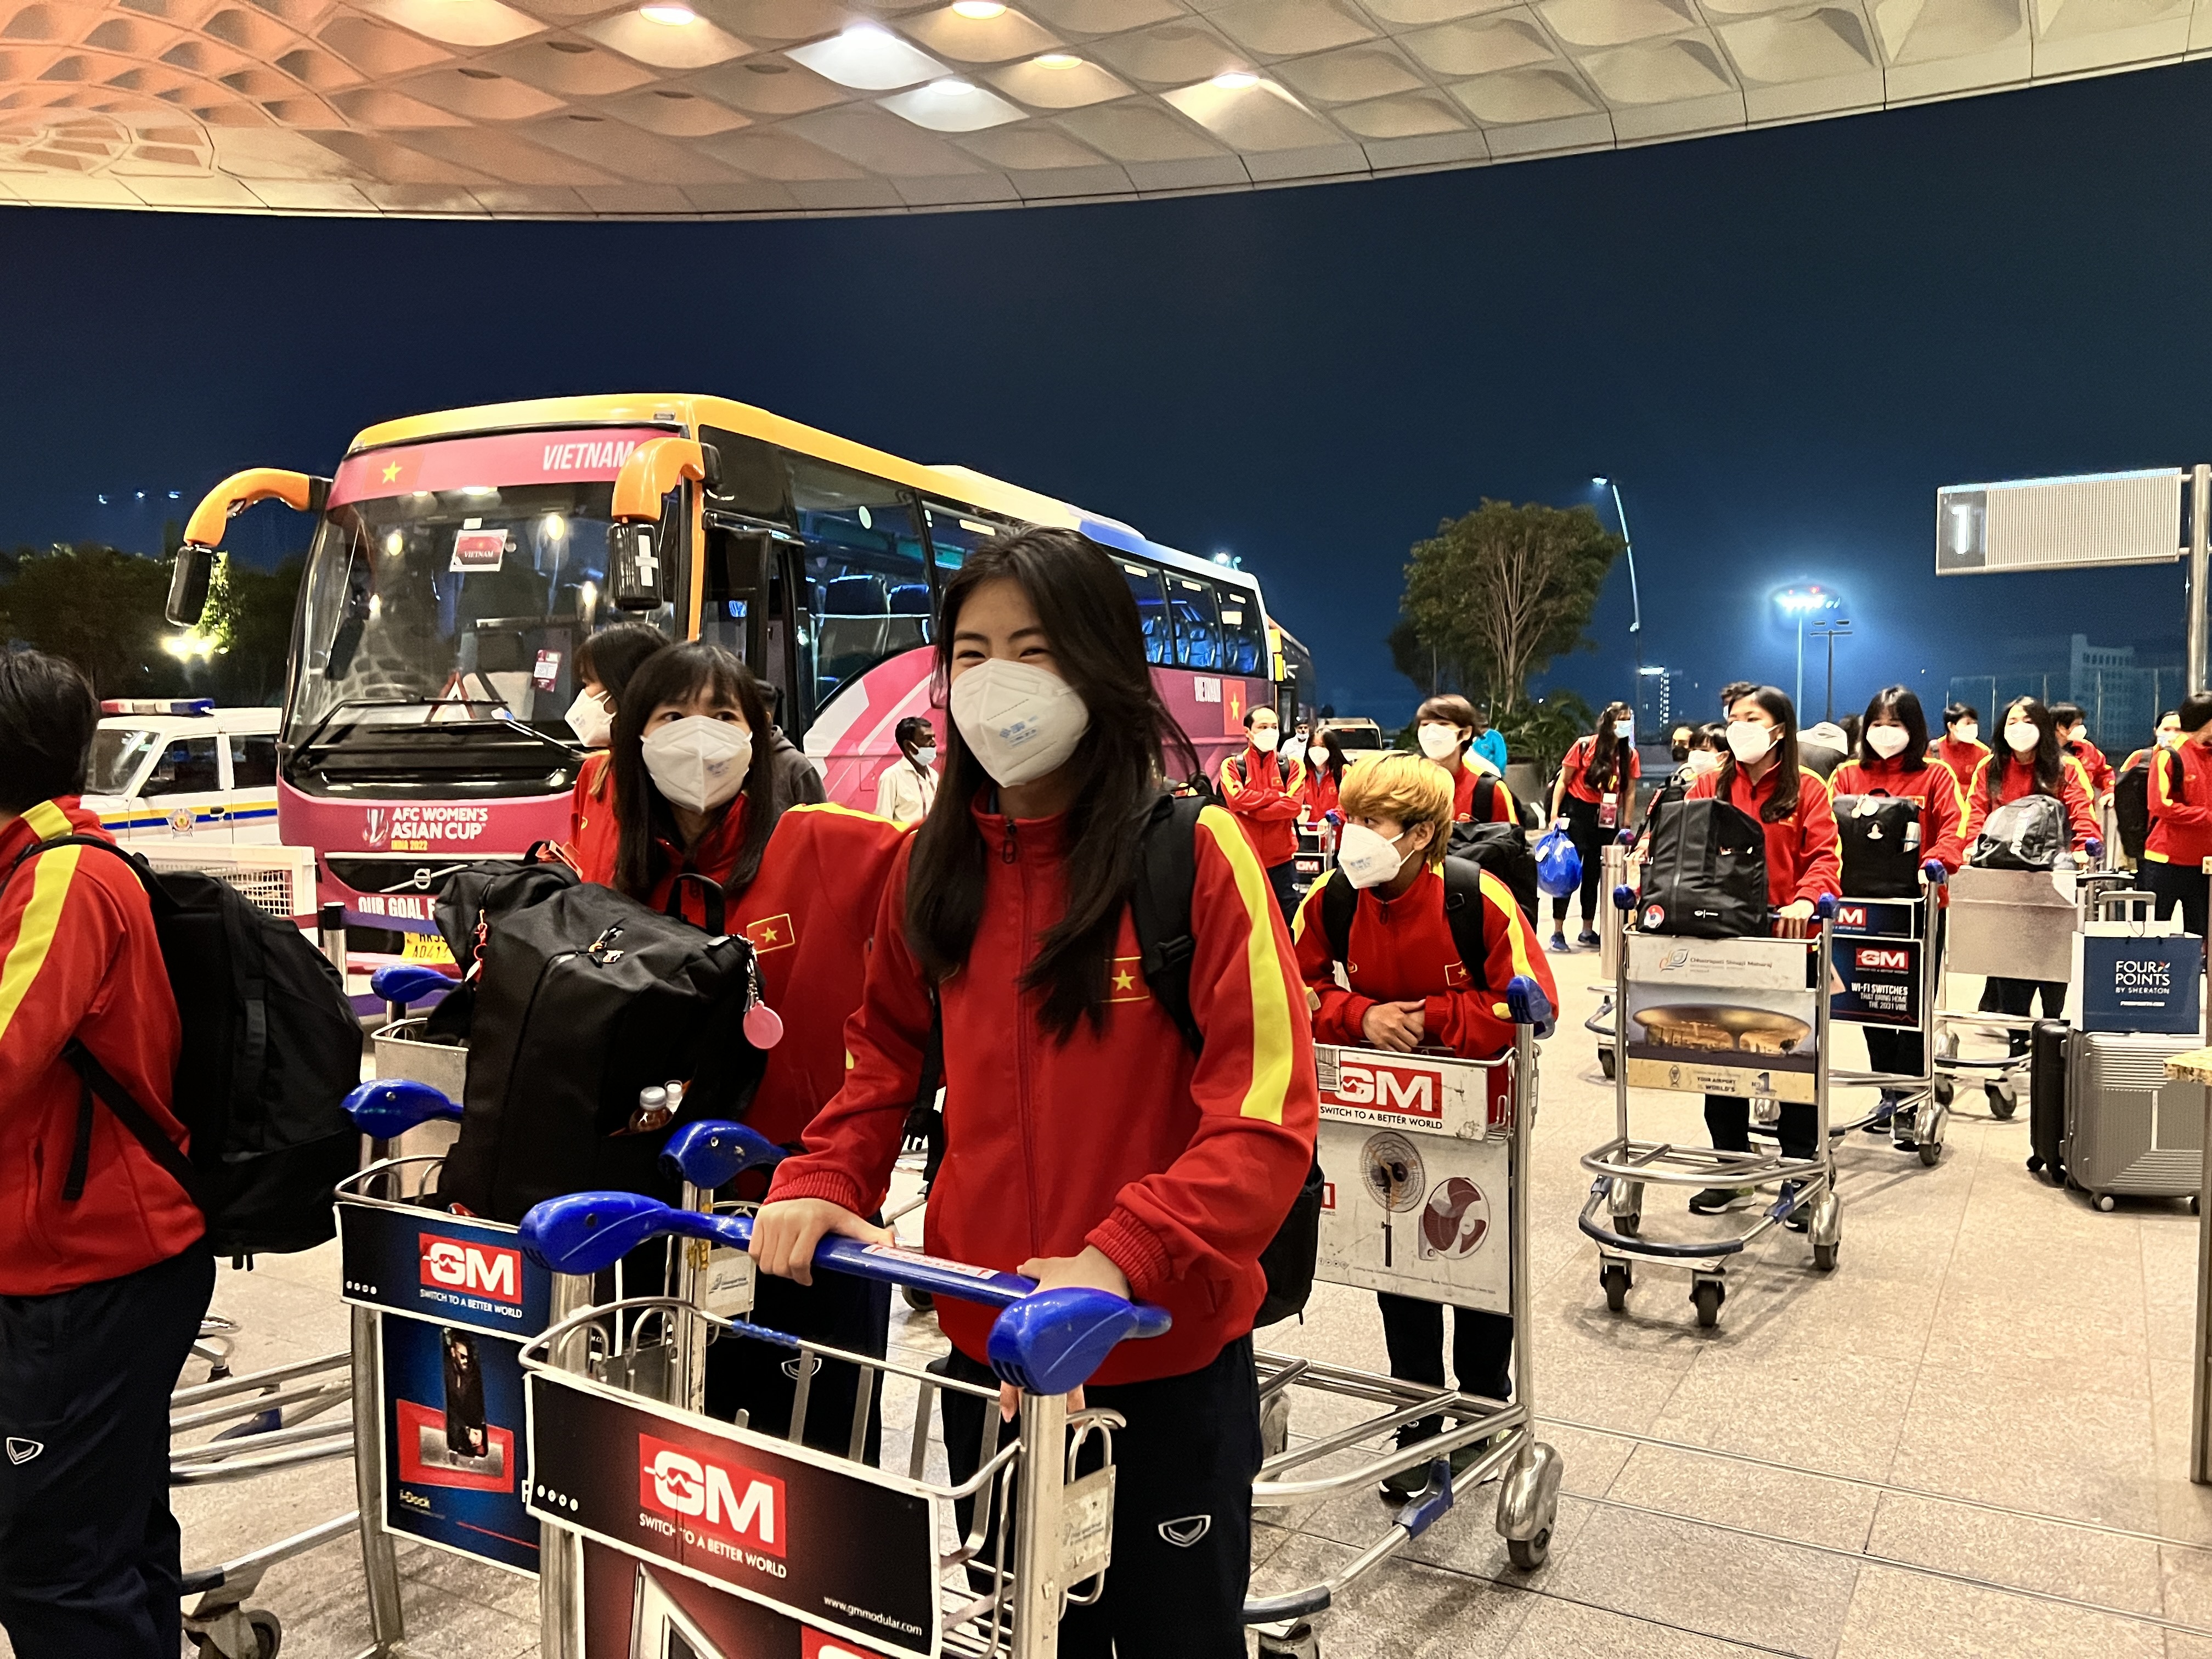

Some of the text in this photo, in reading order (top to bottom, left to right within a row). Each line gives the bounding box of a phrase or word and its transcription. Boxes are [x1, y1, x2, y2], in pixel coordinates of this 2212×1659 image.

[543, 441, 635, 470] VIETNAM
[1951, 505, 1968, 555] 1
[392, 808, 488, 821] AFC WOMEN'S
[391, 822, 482, 839] ASIAN CUP
[410, 840, 427, 850] 2022
[388, 897, 424, 920] GOAL
[1838, 908, 1863, 924] M
[1858, 950, 1905, 968] GM
[2116, 961, 2157, 973] FOUR
[1852, 983, 1908, 996] WI-FI SWITCHES
[2115, 973, 2170, 986] POINTS
[1335, 1066, 1433, 1111] GM
[1320, 1106, 1352, 1117] SWITCH
[1355, 1110, 1366, 1119] TO
[1378, 1113, 1407, 1125] BETTER
[1409, 1118, 1442, 1129] WORLD
[422, 1242, 514, 1296] GM
[420, 1288, 522, 1318] SWITCH TO A BETTER WORLD
[644, 1450, 774, 1544] GM
[639, 1513, 675, 1536] SWITCH
[697, 1536, 706, 1549] A
[707, 1538, 743, 1564] BETTER
[745, 1552, 787, 1578] WORLD
[823, 1596, 922, 1637] www.gmmodular.com
